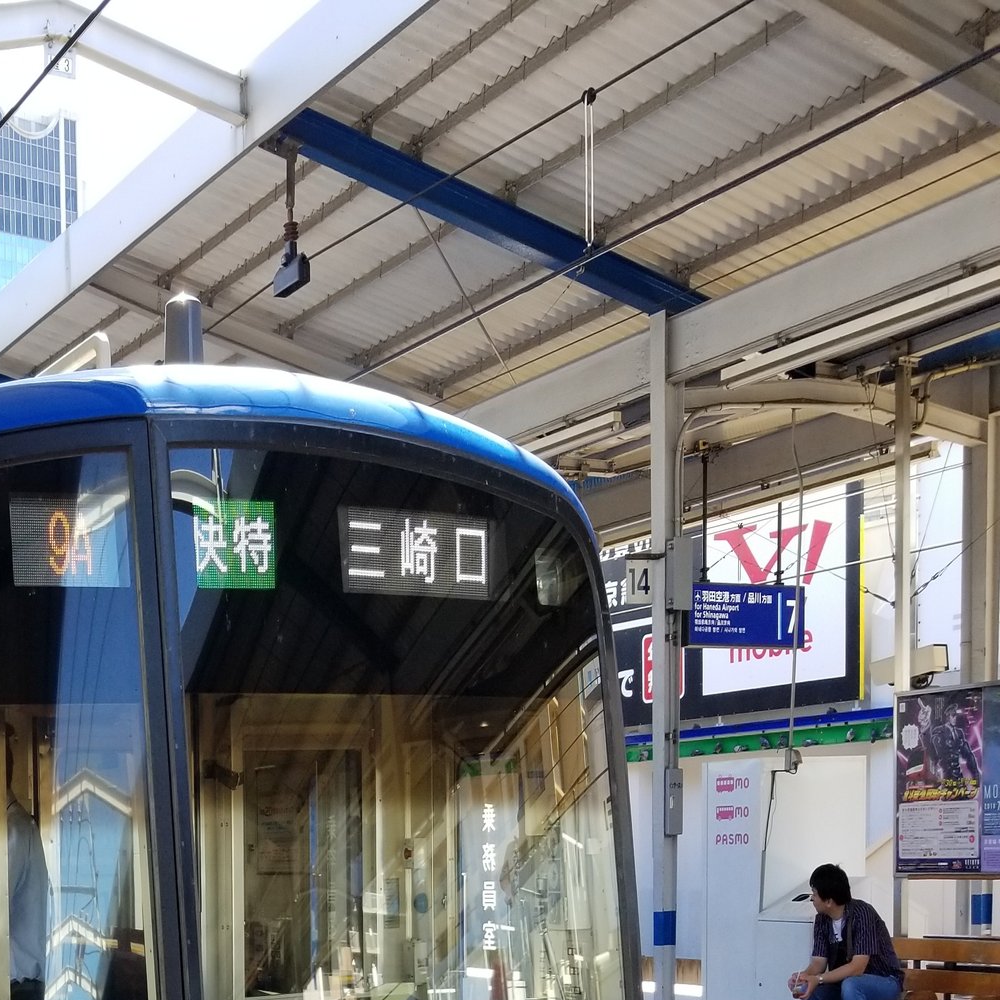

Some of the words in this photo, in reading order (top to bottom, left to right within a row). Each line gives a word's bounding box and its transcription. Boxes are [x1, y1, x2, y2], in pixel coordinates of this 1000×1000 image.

[48, 510, 92, 576] 9A
[193, 515, 272, 574] 快特
[349, 518, 486, 584] 三崎口
[628, 568, 650, 596] 14
[703, 603, 721, 611] Haneda
[722, 604, 739, 612] Airport
[703, 611, 729, 620] Shinagawa
[786, 599, 798, 634] 7
[729, 629, 814, 664] moe
[618, 669, 635, 698] で
[715, 833, 749, 845] PASMO
[482, 803, 497, 951] 乗務員室
